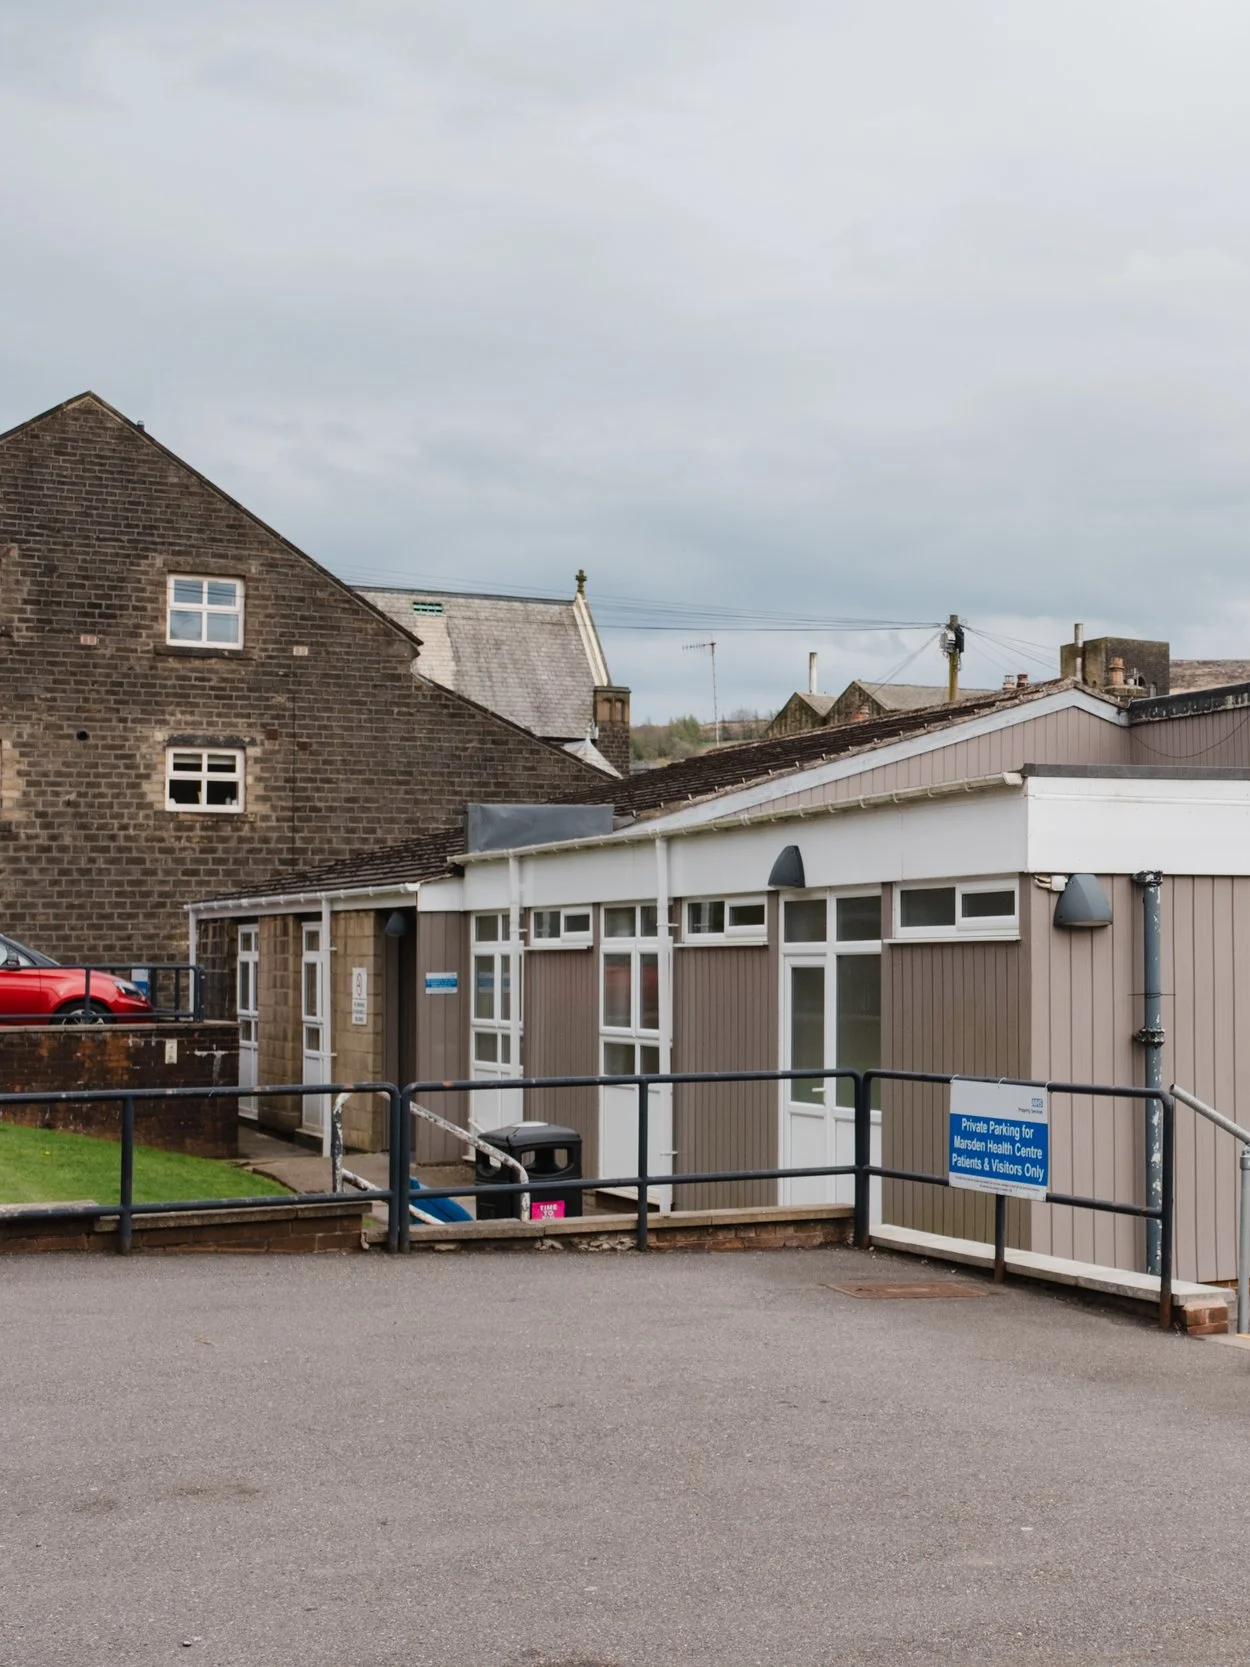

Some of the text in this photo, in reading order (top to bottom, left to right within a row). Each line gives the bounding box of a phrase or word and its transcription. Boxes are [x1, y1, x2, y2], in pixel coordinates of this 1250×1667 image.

[961, 1118, 1034, 1140] Private Parking for
[954, 1135, 1043, 1160] Marsden Health Centre
[951, 1153, 1045, 1182] Patients & Visitors Only
